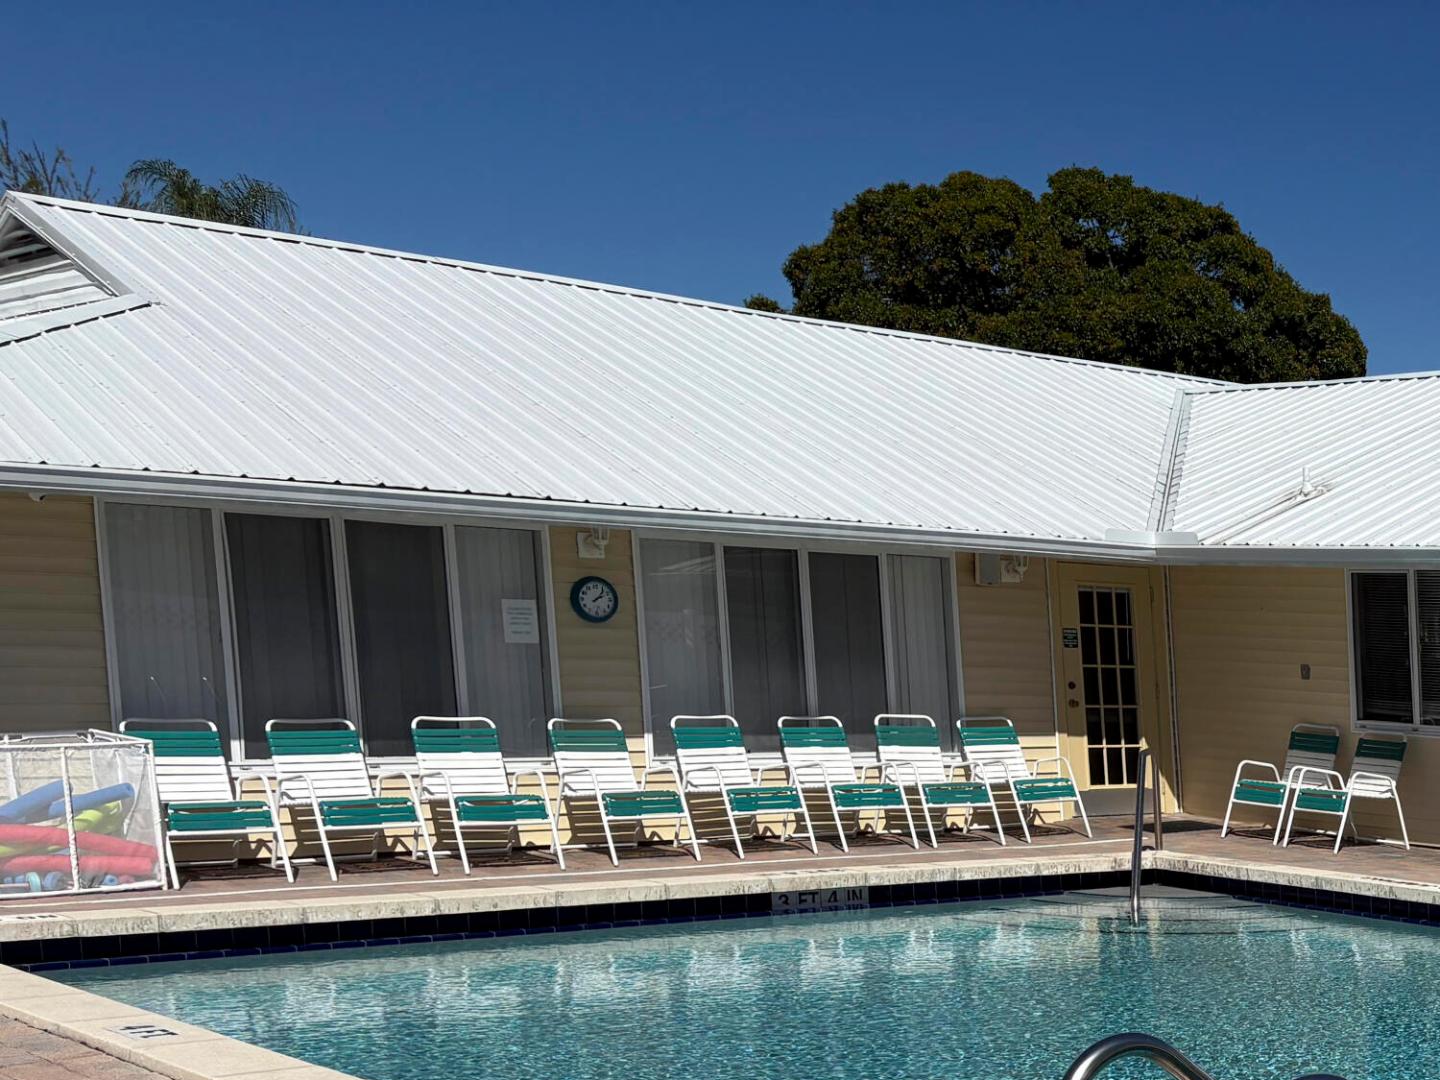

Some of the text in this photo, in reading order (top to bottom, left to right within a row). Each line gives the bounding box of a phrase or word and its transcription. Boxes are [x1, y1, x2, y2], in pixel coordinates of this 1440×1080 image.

[798, 891, 819, 905] FT
[827, 890, 839, 903] 4
[847, 888, 863, 901] IN
